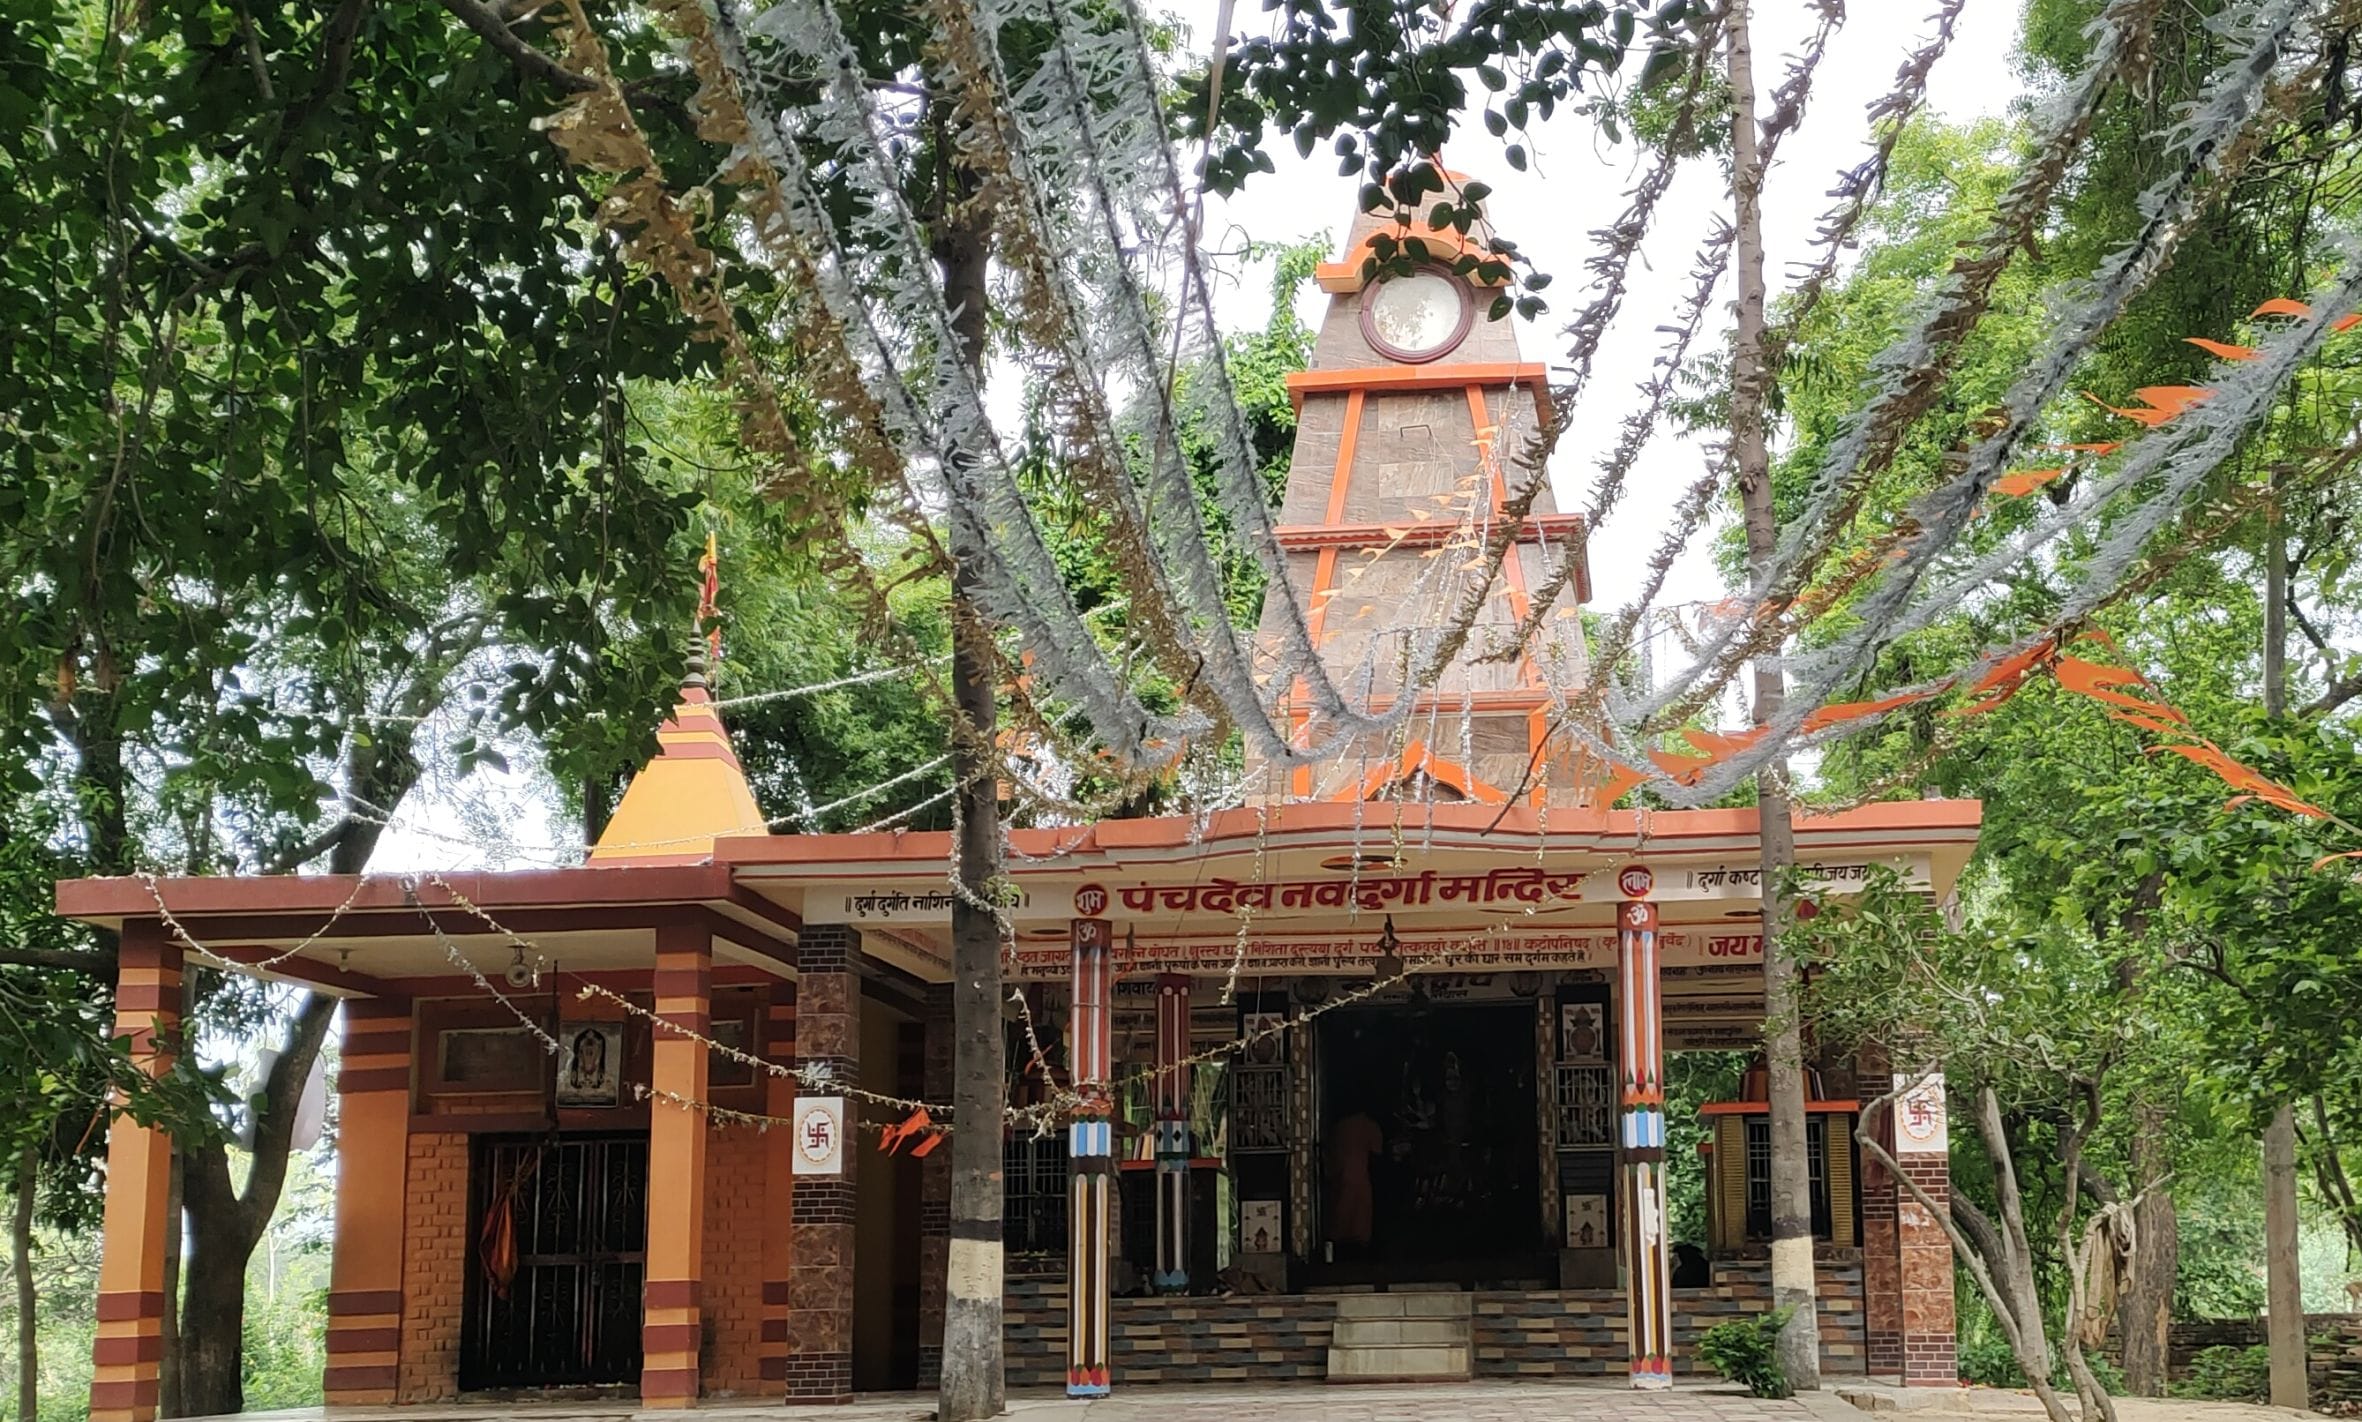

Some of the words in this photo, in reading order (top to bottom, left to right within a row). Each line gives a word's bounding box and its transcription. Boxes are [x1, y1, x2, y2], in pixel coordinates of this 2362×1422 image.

[1439, 866, 1587, 903] मन्दिर
[1621, 871, 1652, 895] लाभ
[1698, 865, 1727, 892] दुर्गा
[854, 890, 877, 917] दुर्गा
[878, 890, 911, 917] दुर्गति
[1076, 890, 1105, 915] शुभ
[1709, 935, 1751, 957] जय
